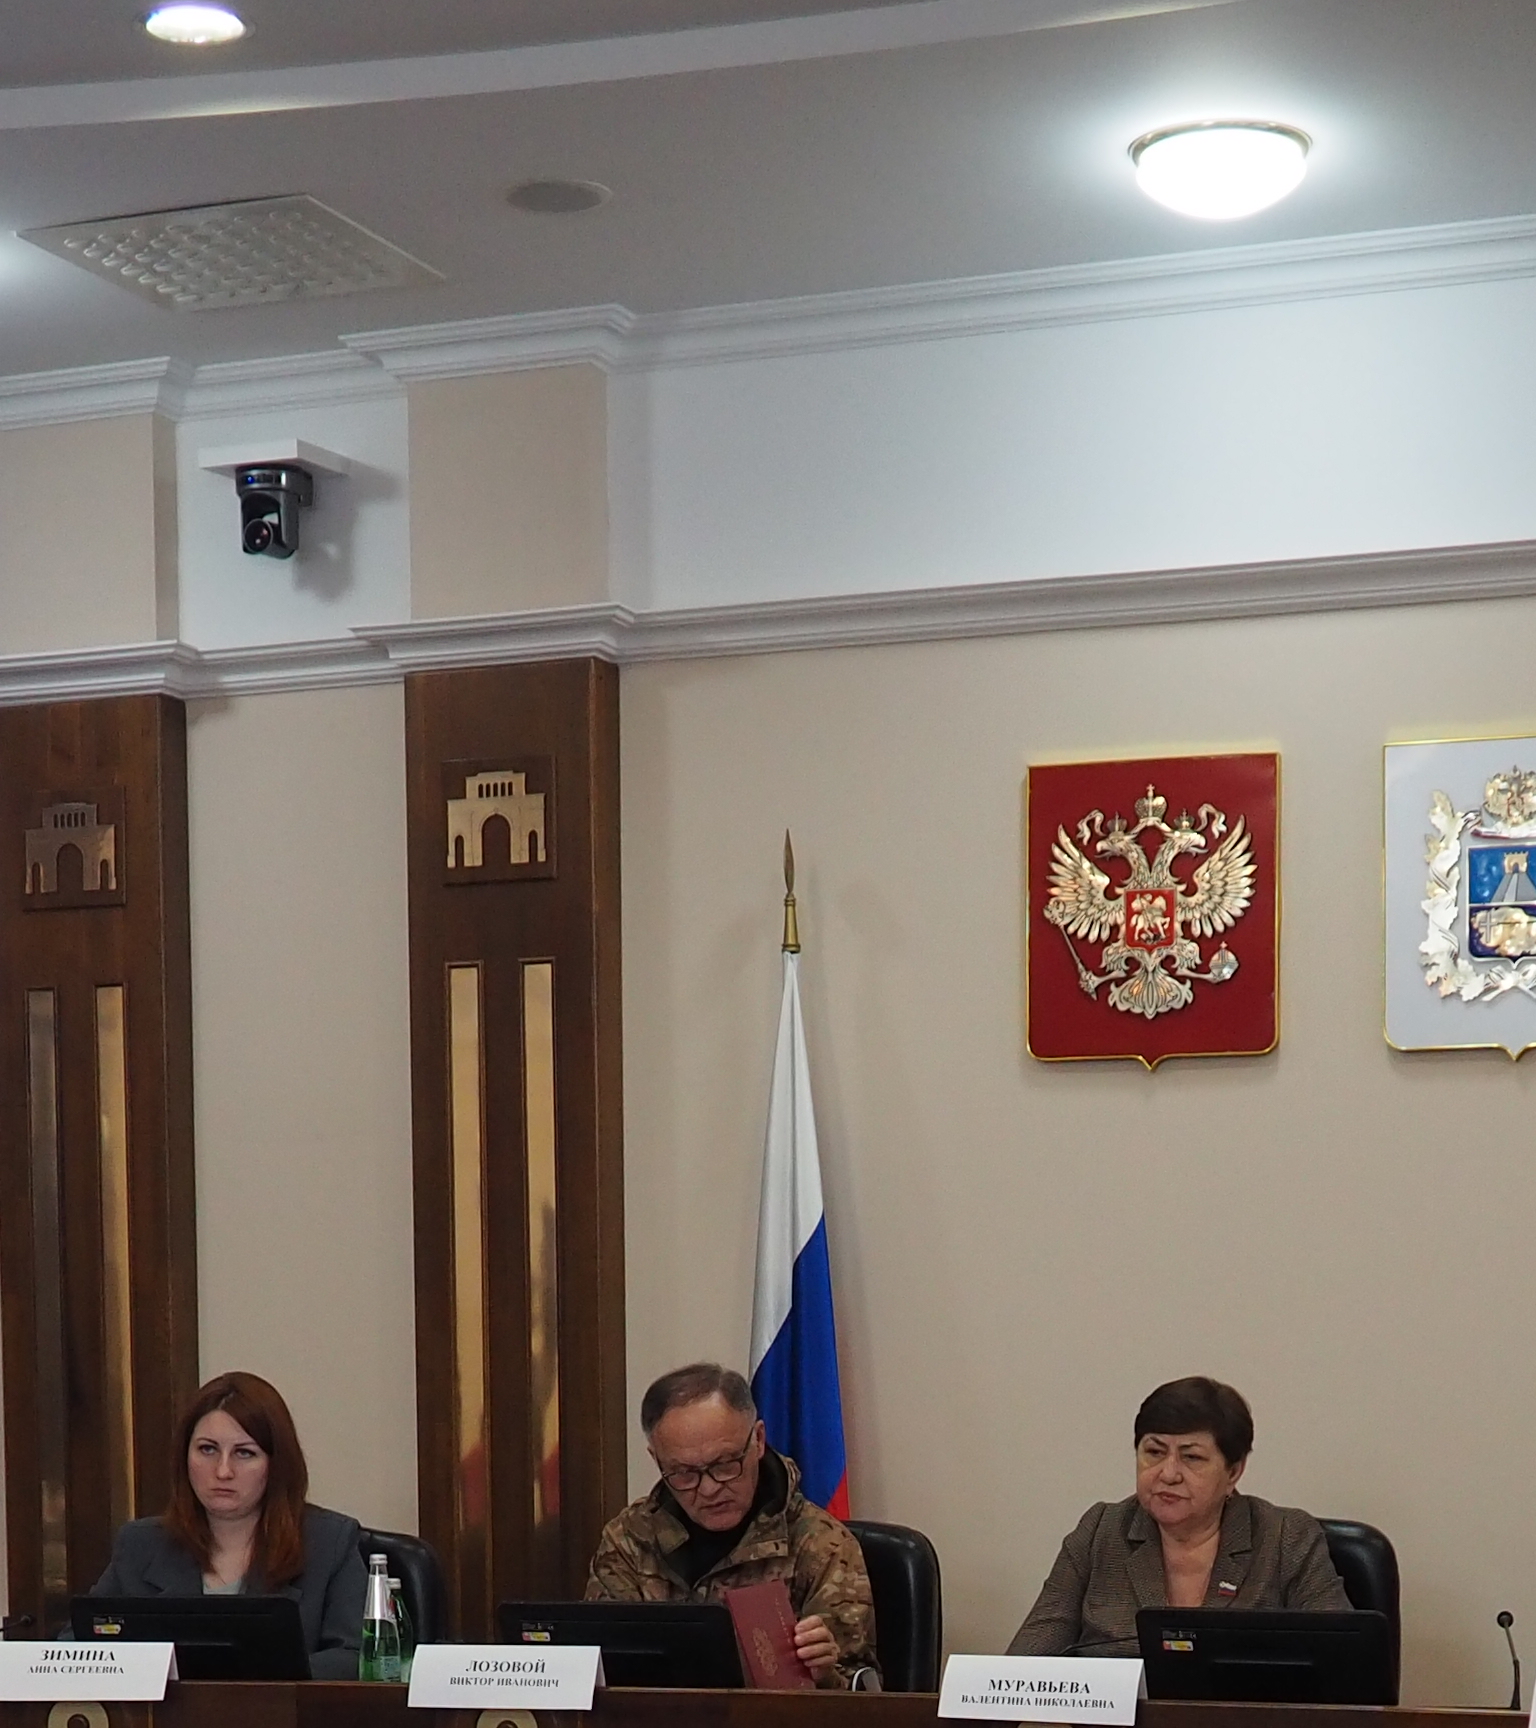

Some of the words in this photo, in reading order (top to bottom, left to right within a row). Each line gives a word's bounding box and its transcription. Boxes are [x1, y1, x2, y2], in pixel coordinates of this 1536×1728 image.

[41, 1649, 116, 1662] ЗИМИНА
[27, 1665, 58, 1675] АННА
[60, 1665, 125, 1675] СЕРГЕЕВНА
[465, 1658, 547, 1675] ЛОЗОВОЙ
[449, 1676, 495, 1687] ВИКТОР
[497, 1677, 560, 1688] ИВАНОВИЧ
[988, 1679, 1092, 1695] МУРАВЬЕВА
[961, 1694, 1032, 1707] ВАЛЕНТИНА
[1034, 1697, 1116, 1710] НИКОЛАЕВНА
